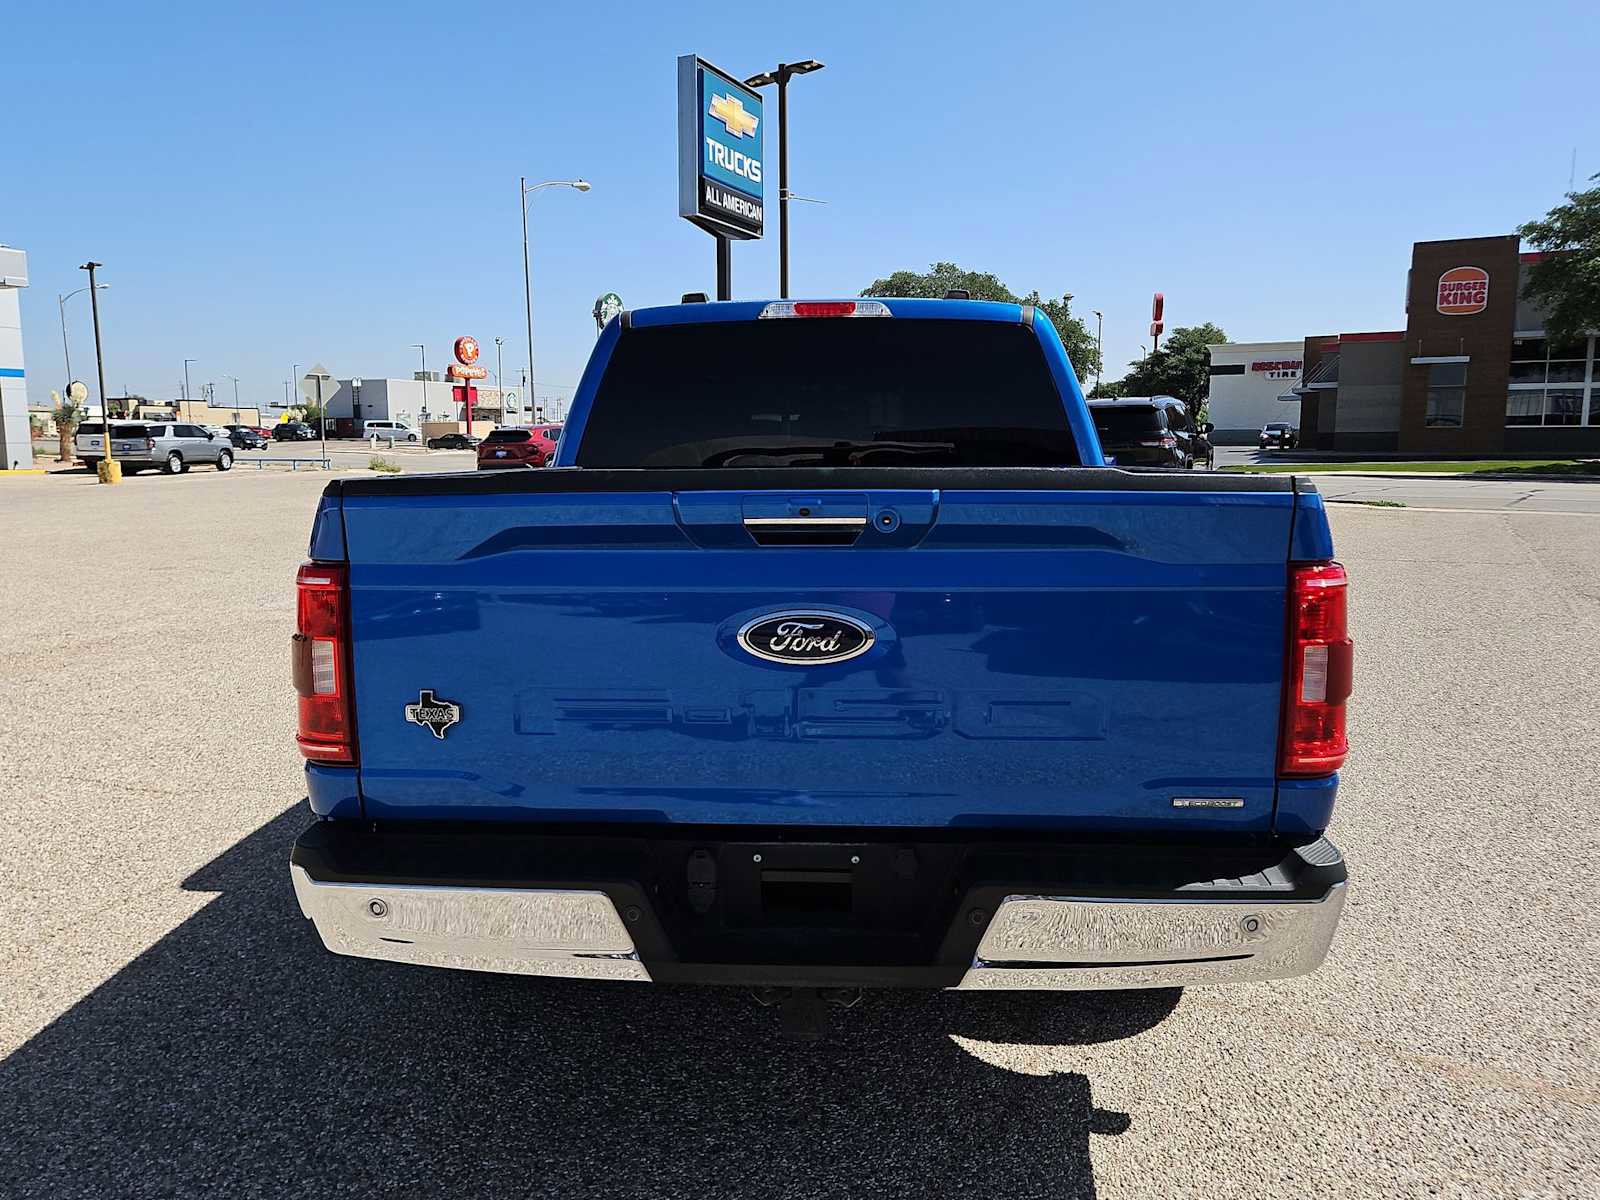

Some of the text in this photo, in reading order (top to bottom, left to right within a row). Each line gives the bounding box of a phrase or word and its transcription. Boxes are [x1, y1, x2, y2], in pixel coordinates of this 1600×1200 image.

[705, 136, 762, 183] TRUCKS
[705, 186, 762, 221] ALL AMERICAN
[1439, 290, 1486, 305] KING
[1440, 281, 1487, 292] BURGER
[769, 622, 842, 651] Ford
[409, 707, 454, 720] TEXAS
